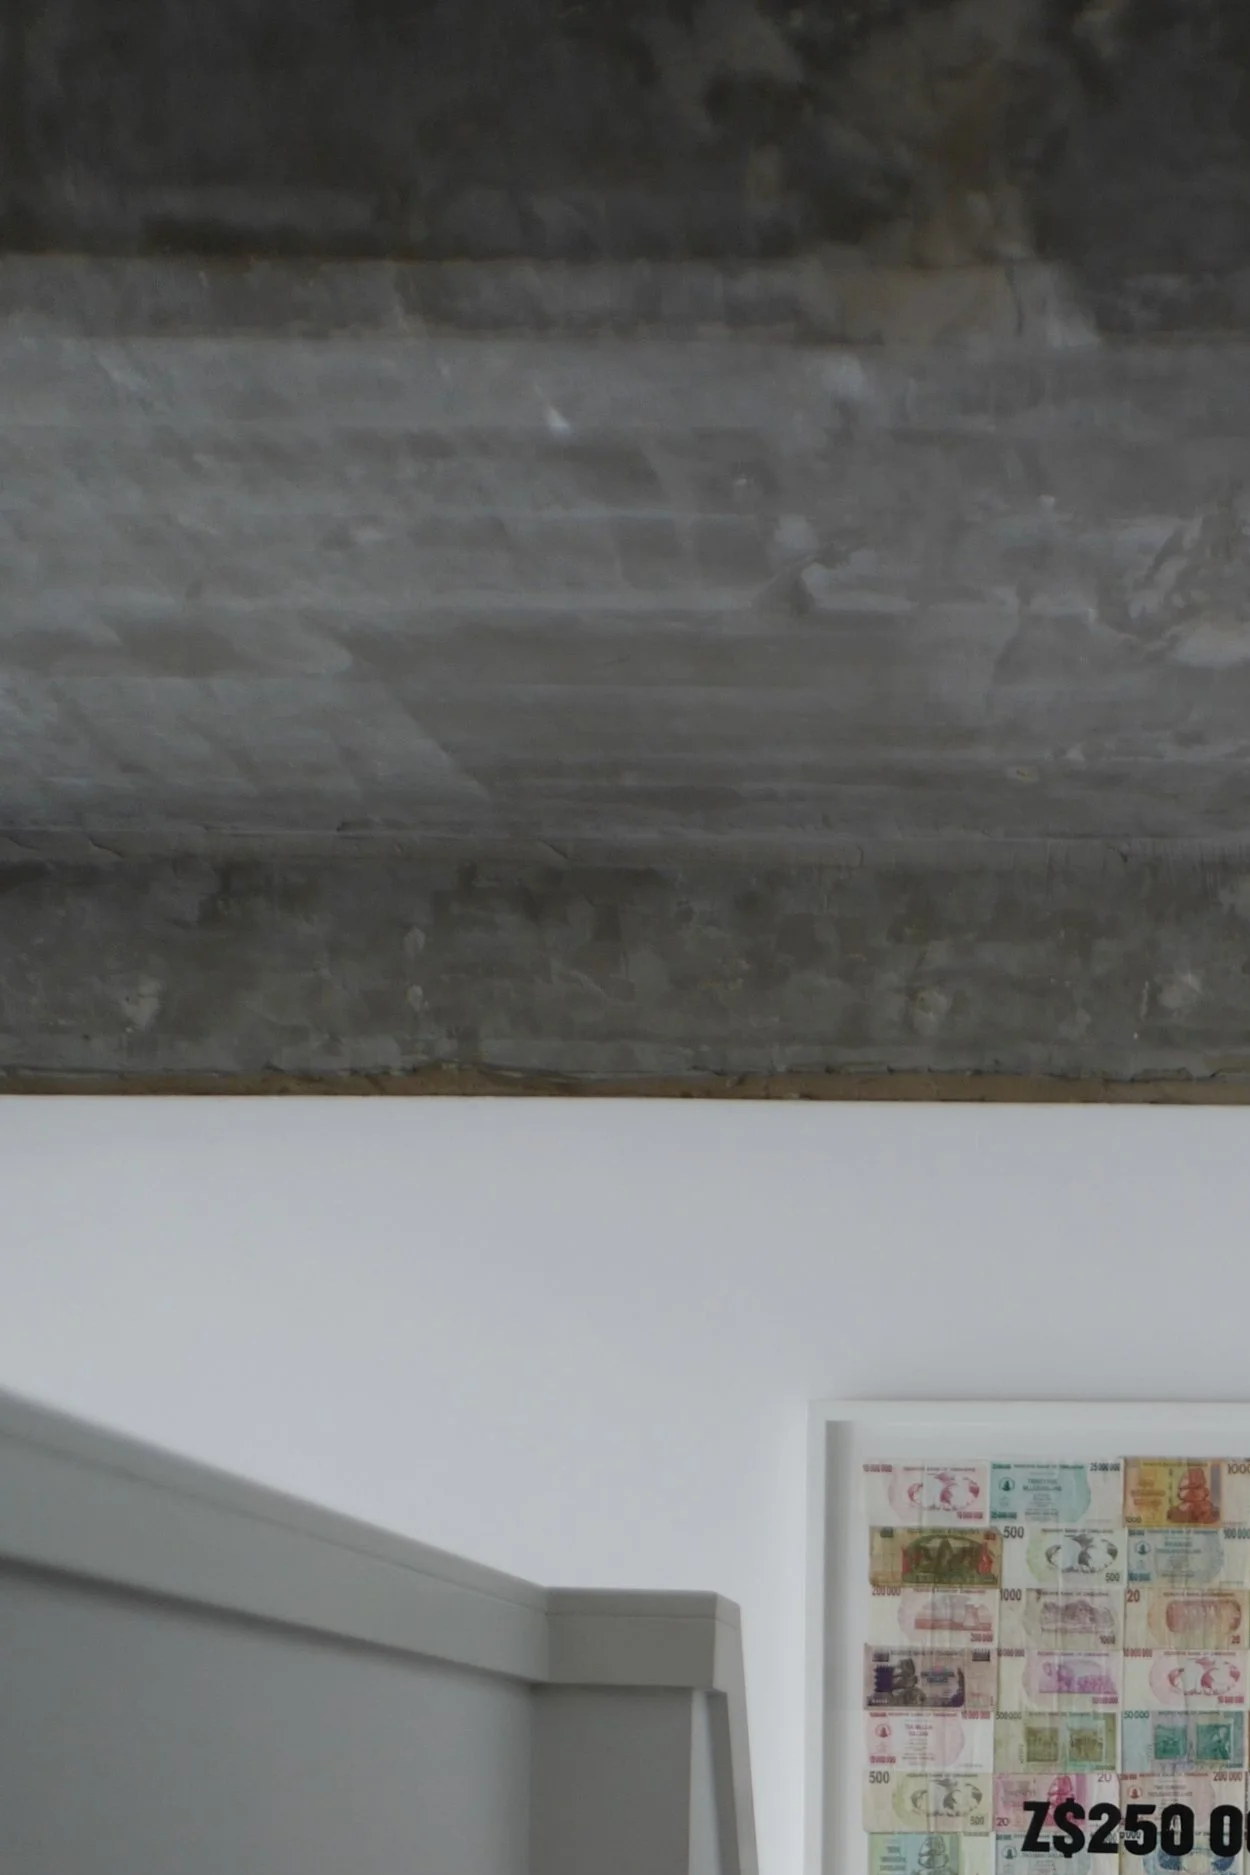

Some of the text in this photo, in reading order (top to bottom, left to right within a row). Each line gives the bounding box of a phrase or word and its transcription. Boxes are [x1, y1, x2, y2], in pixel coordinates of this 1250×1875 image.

[1004, 1527, 1025, 1539] 500
[1105, 1572, 1120, 1583] 500
[1000, 1588, 1022, 1601] 1000
[1127, 1590, 1140, 1602] 20
[869, 1771, 890, 1784] 500
[970, 1815, 985, 1825] 500
[1021, 1797, 1195, 1858] Z$250
